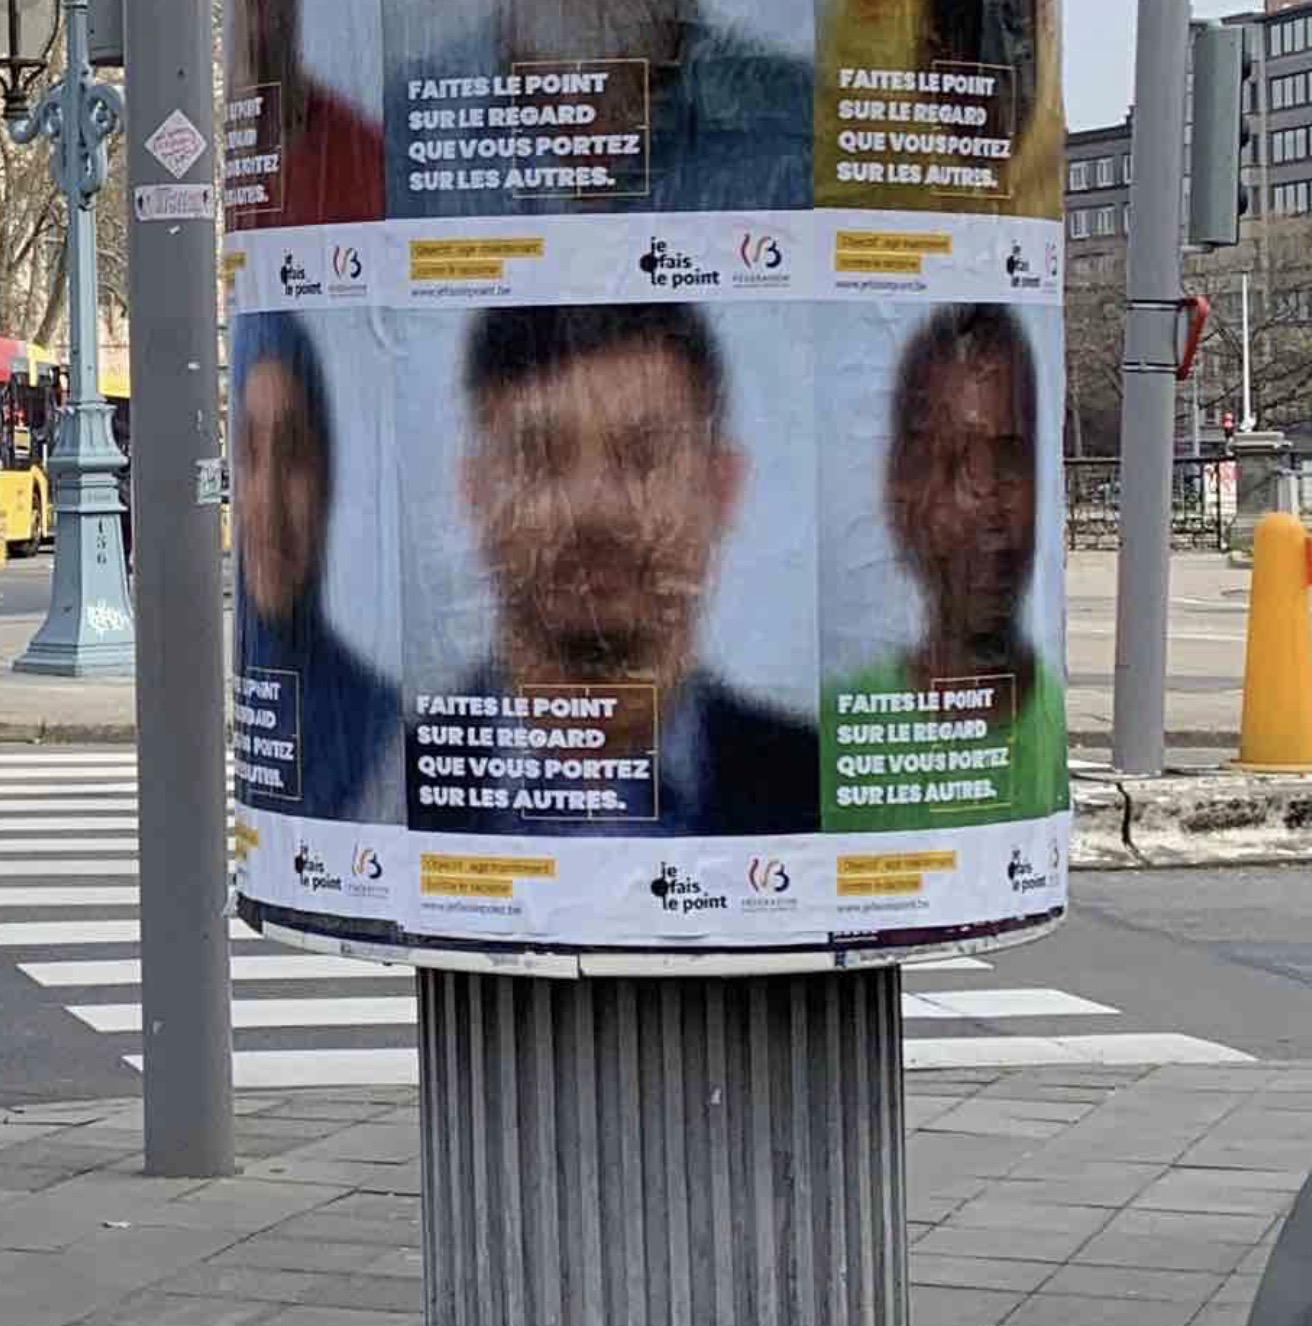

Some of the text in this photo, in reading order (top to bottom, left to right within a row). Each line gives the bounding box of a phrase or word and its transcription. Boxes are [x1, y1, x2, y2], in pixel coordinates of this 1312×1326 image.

[408, 73, 609, 100] FAITES LE POINT
[838, 68, 996, 96] FAITES LE POINT
[408, 104, 596, 131] SUR LE REGARD
[838, 100, 987, 126] SUR LE REGARD
[408, 134, 641, 163] QUE VOUS PORTEZ
[839, 131, 1011, 158] QUE VOUS PORTEZ
[409, 166, 616, 191] SUR LES AUTRES.
[837, 162, 998, 188] SUR LES AUTRES.
[651, 236, 667, 255] je
[658, 253, 693, 270] fais
[651, 268, 720, 289] le point
[416, 695, 618, 717] FAITES LE POINT
[838, 688, 995, 714] FAITES LE POINT
[417, 726, 606, 748] SUR LE REGARD
[837, 719, 987, 744] SUR LE REGARD
[418, 756, 651, 779] QUE VOUS PORTEZ
[837, 747, 1009, 778] QUE VOUS PORTEZ
[419, 786, 627, 810] SUR LES AUTRES.
[837, 779, 997, 806] SUR LES AUTRES.
[661, 861, 677, 880] je
[669, 877, 701, 895] fais
[662, 895, 678, 911] le
[682, 891, 728, 914] point
